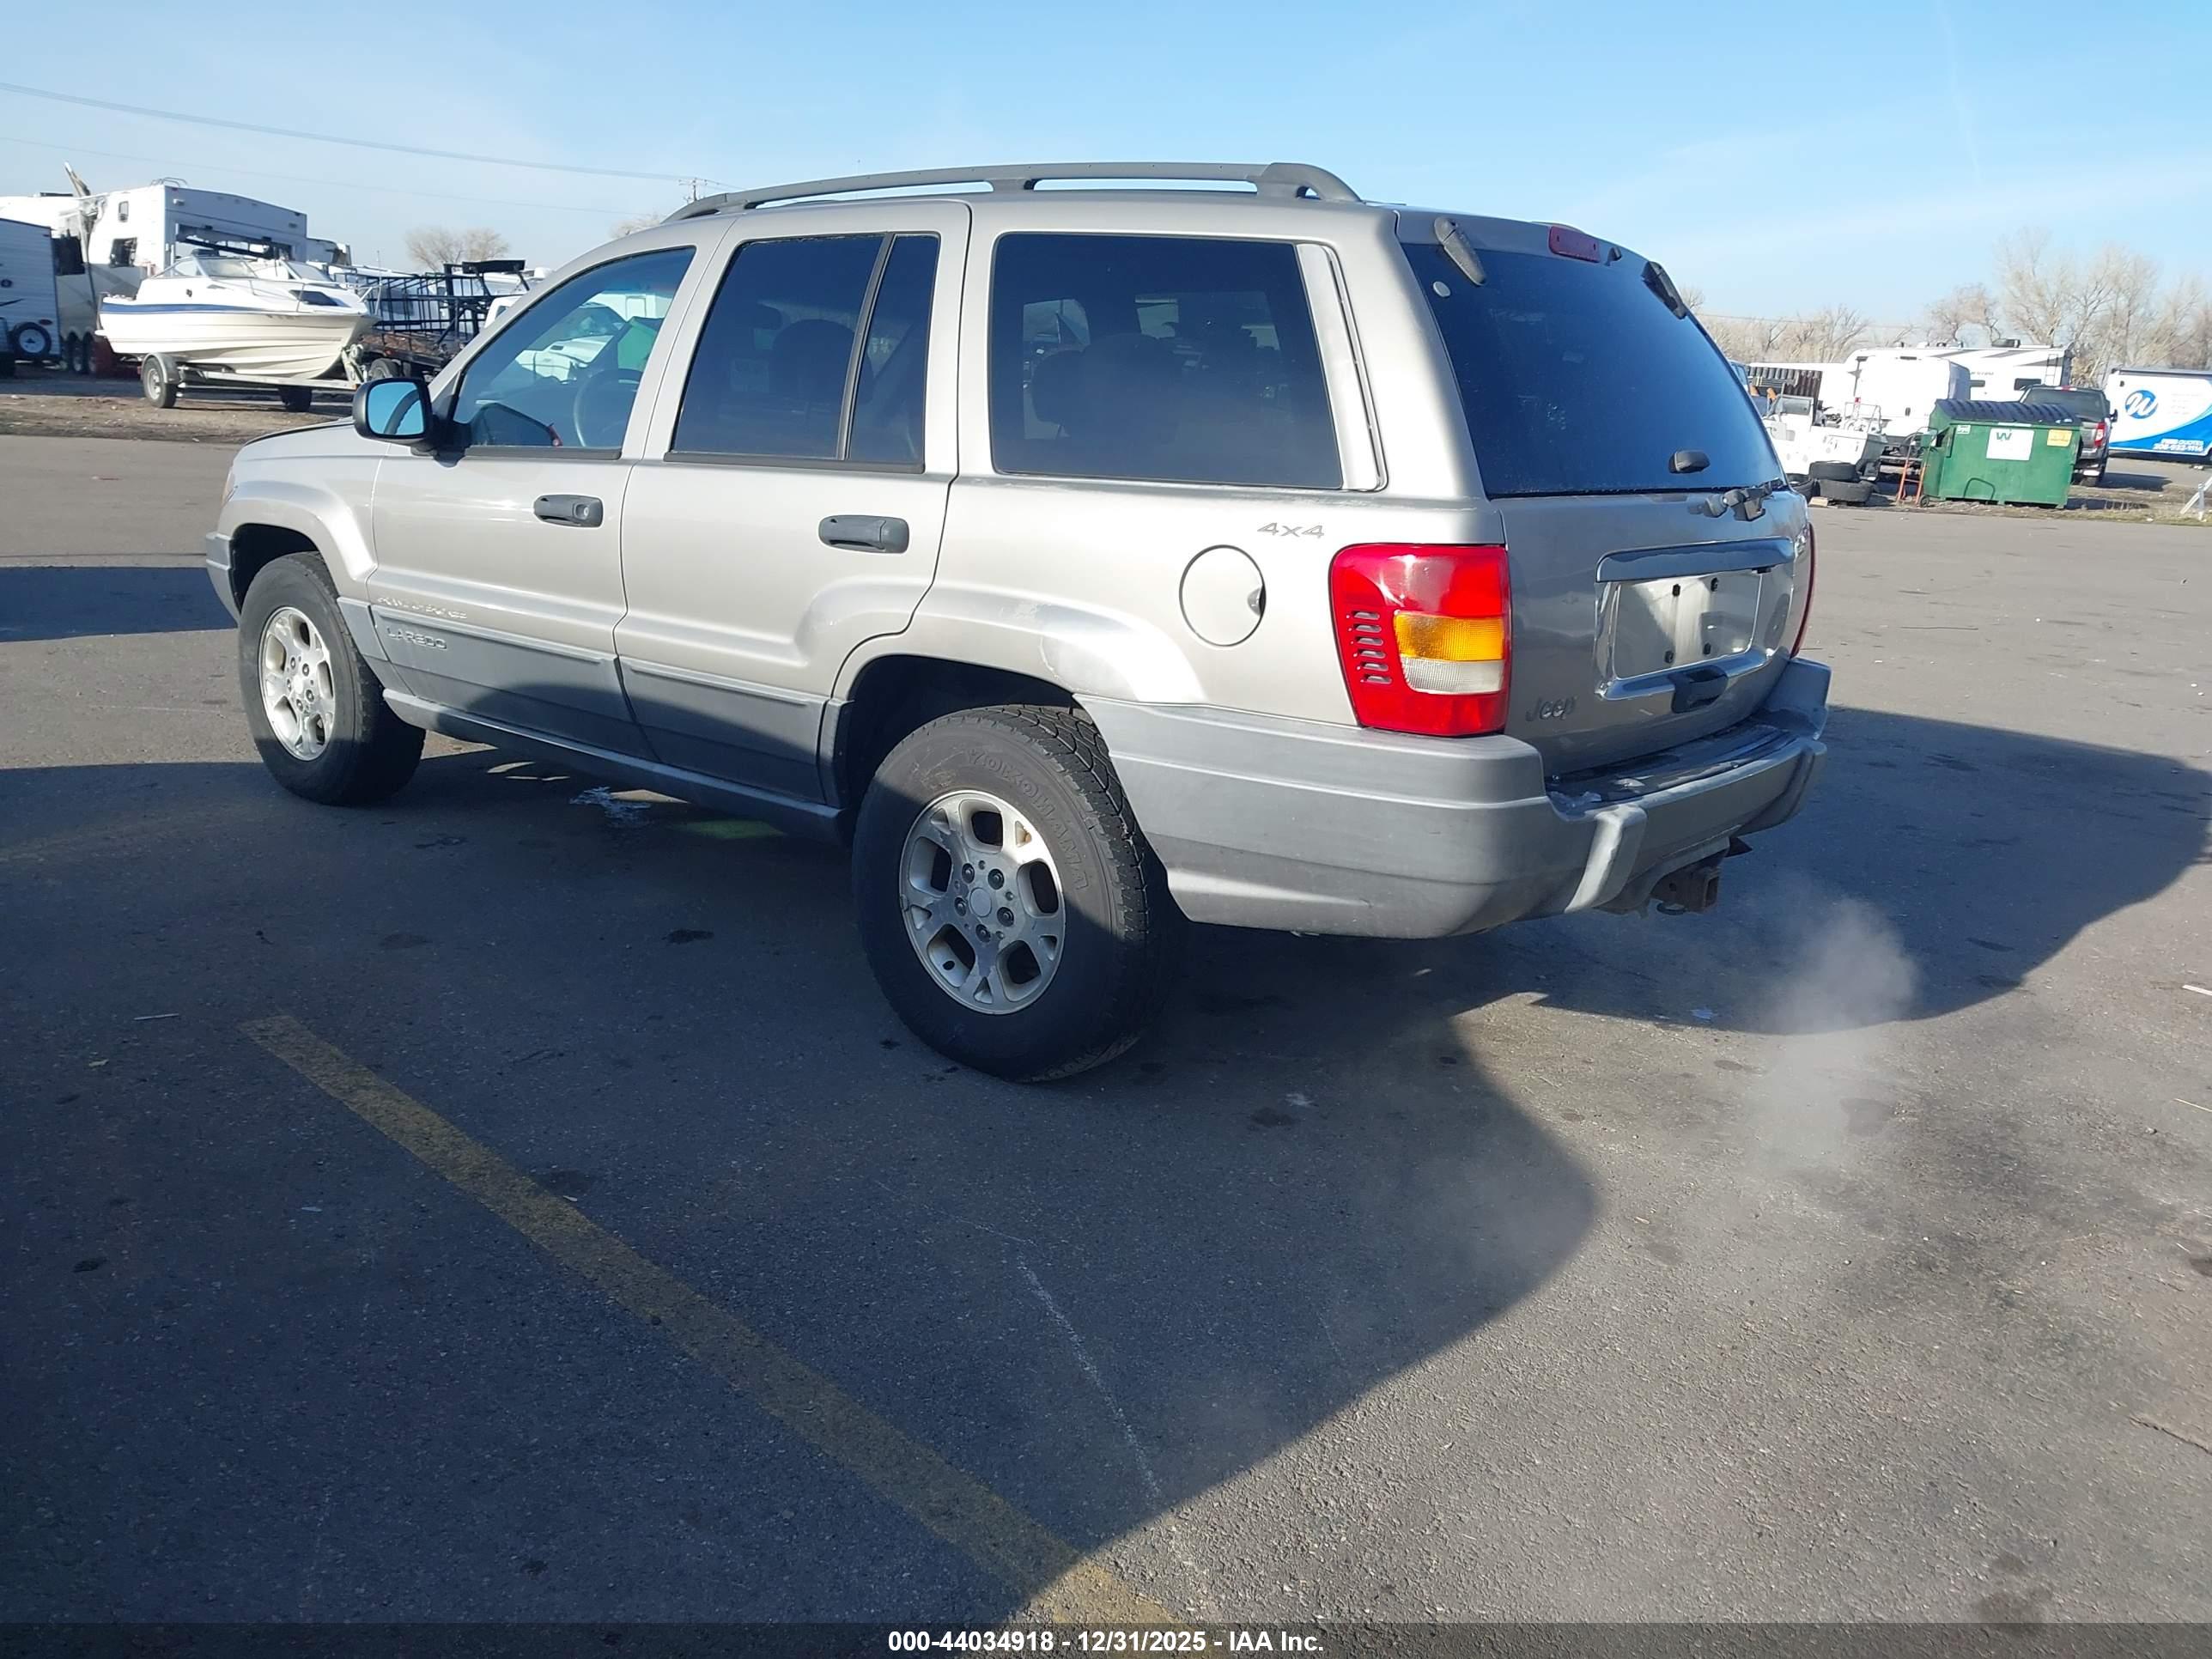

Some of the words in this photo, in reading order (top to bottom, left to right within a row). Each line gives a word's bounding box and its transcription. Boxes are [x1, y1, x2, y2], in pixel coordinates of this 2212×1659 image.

[386, 627, 447, 651] LAREDO
[1525, 696, 1578, 722] Jeep
[965, 748, 1090, 890] YOKOHAMA
